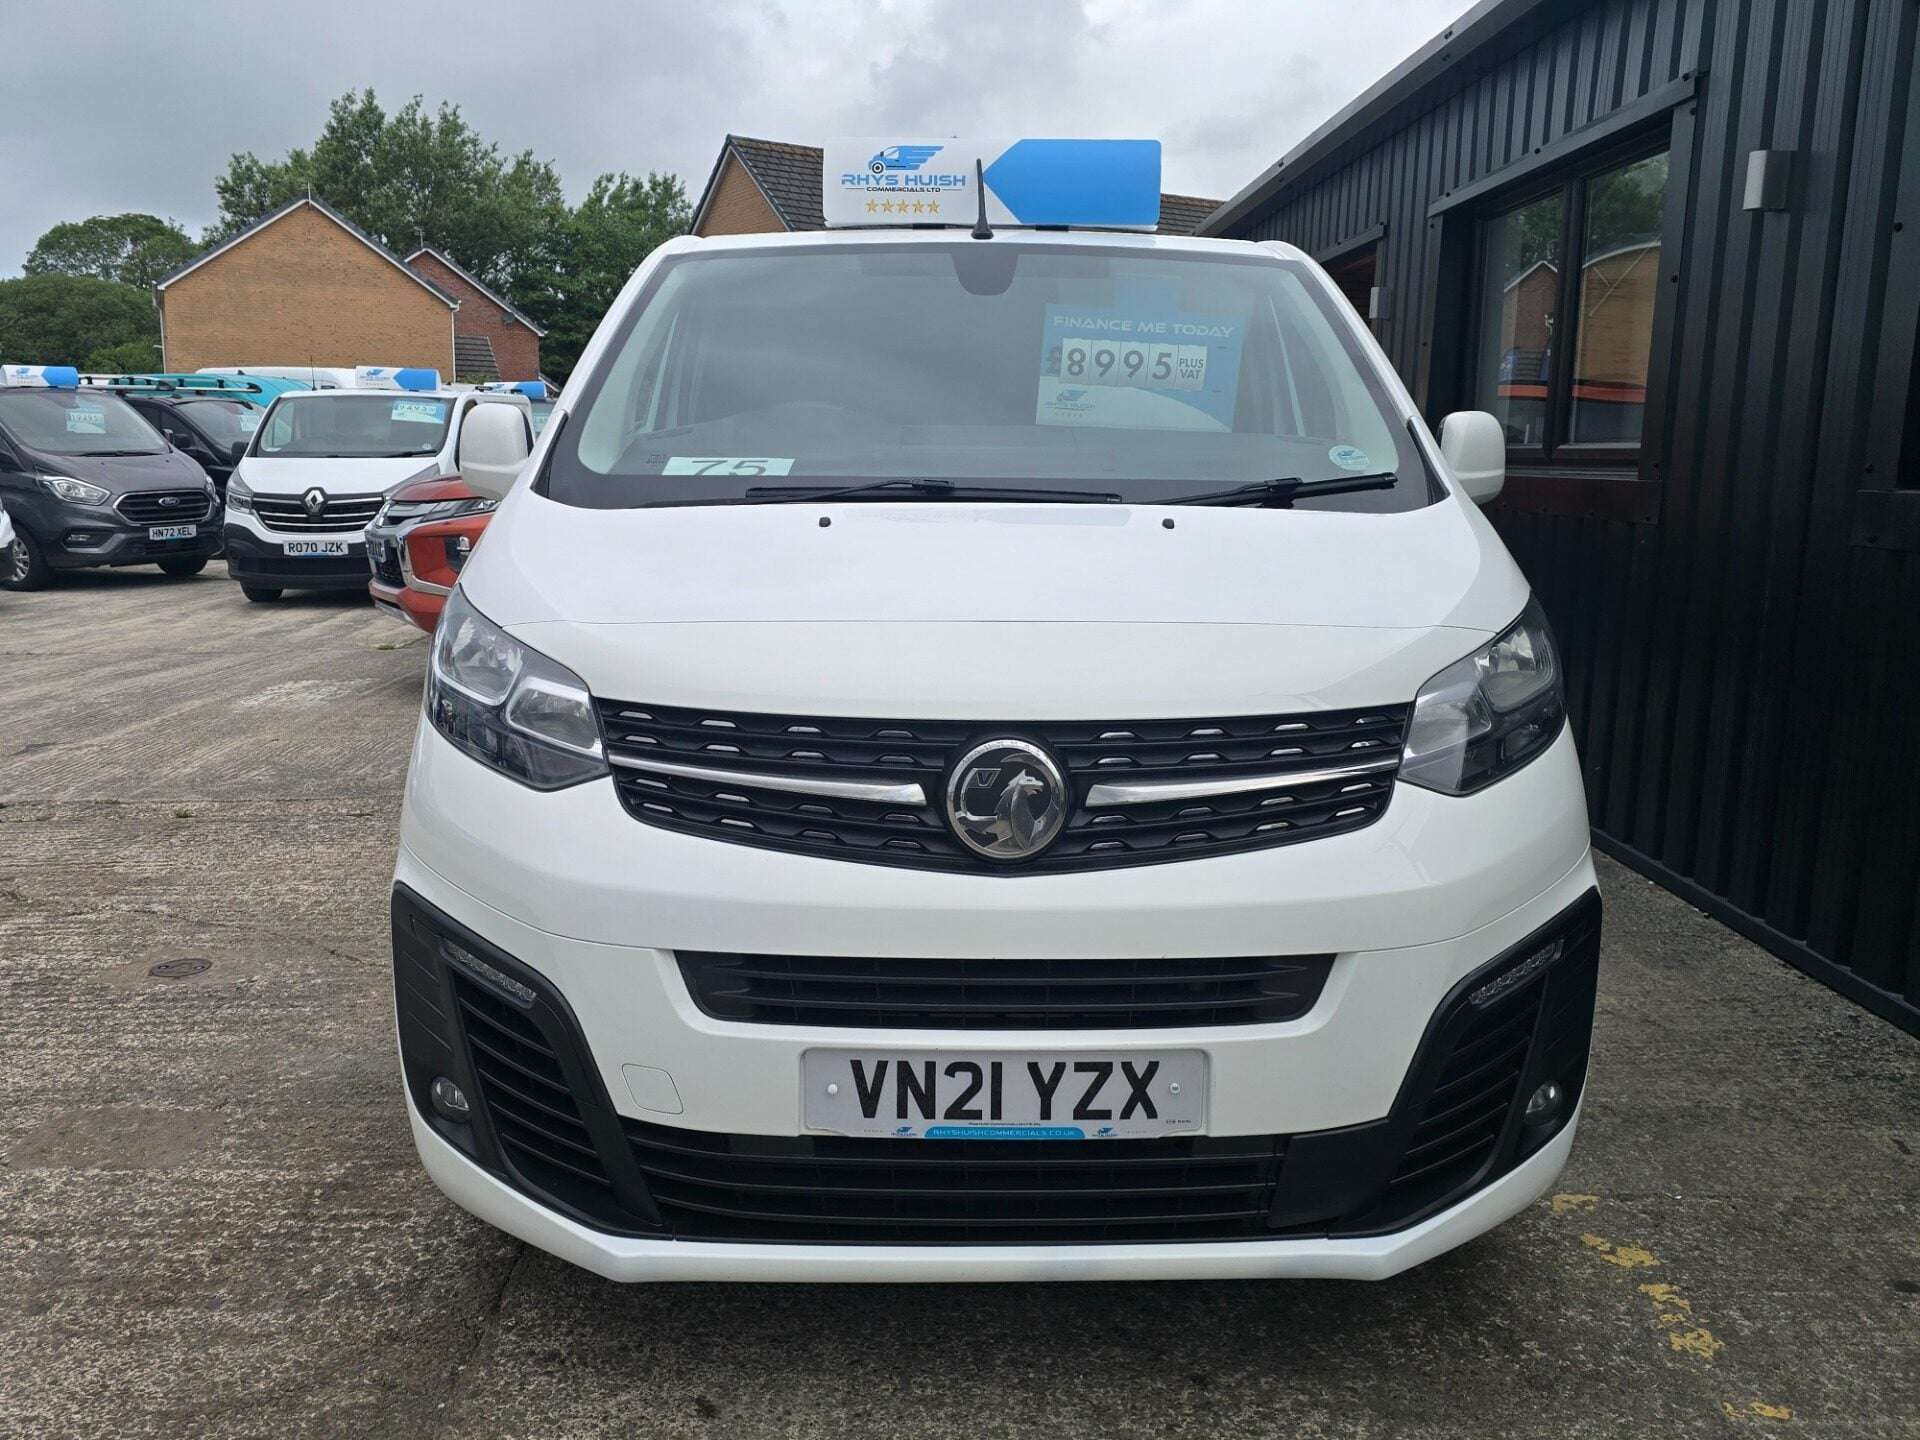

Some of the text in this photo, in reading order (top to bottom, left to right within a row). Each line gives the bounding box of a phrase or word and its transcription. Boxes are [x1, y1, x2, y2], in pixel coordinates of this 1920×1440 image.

[841, 174, 966, 187] RHYS HUISH
[1053, 315, 1235, 337] FINANCE ME TODAY
[1178, 357, 1204, 369] PLUS
[1180, 368, 1202, 379] VAT
[152, 526, 192, 537] HN72 XEL
[321, 542, 344, 553] JZK
[850, 1059, 1161, 1121] VN21 YZX
